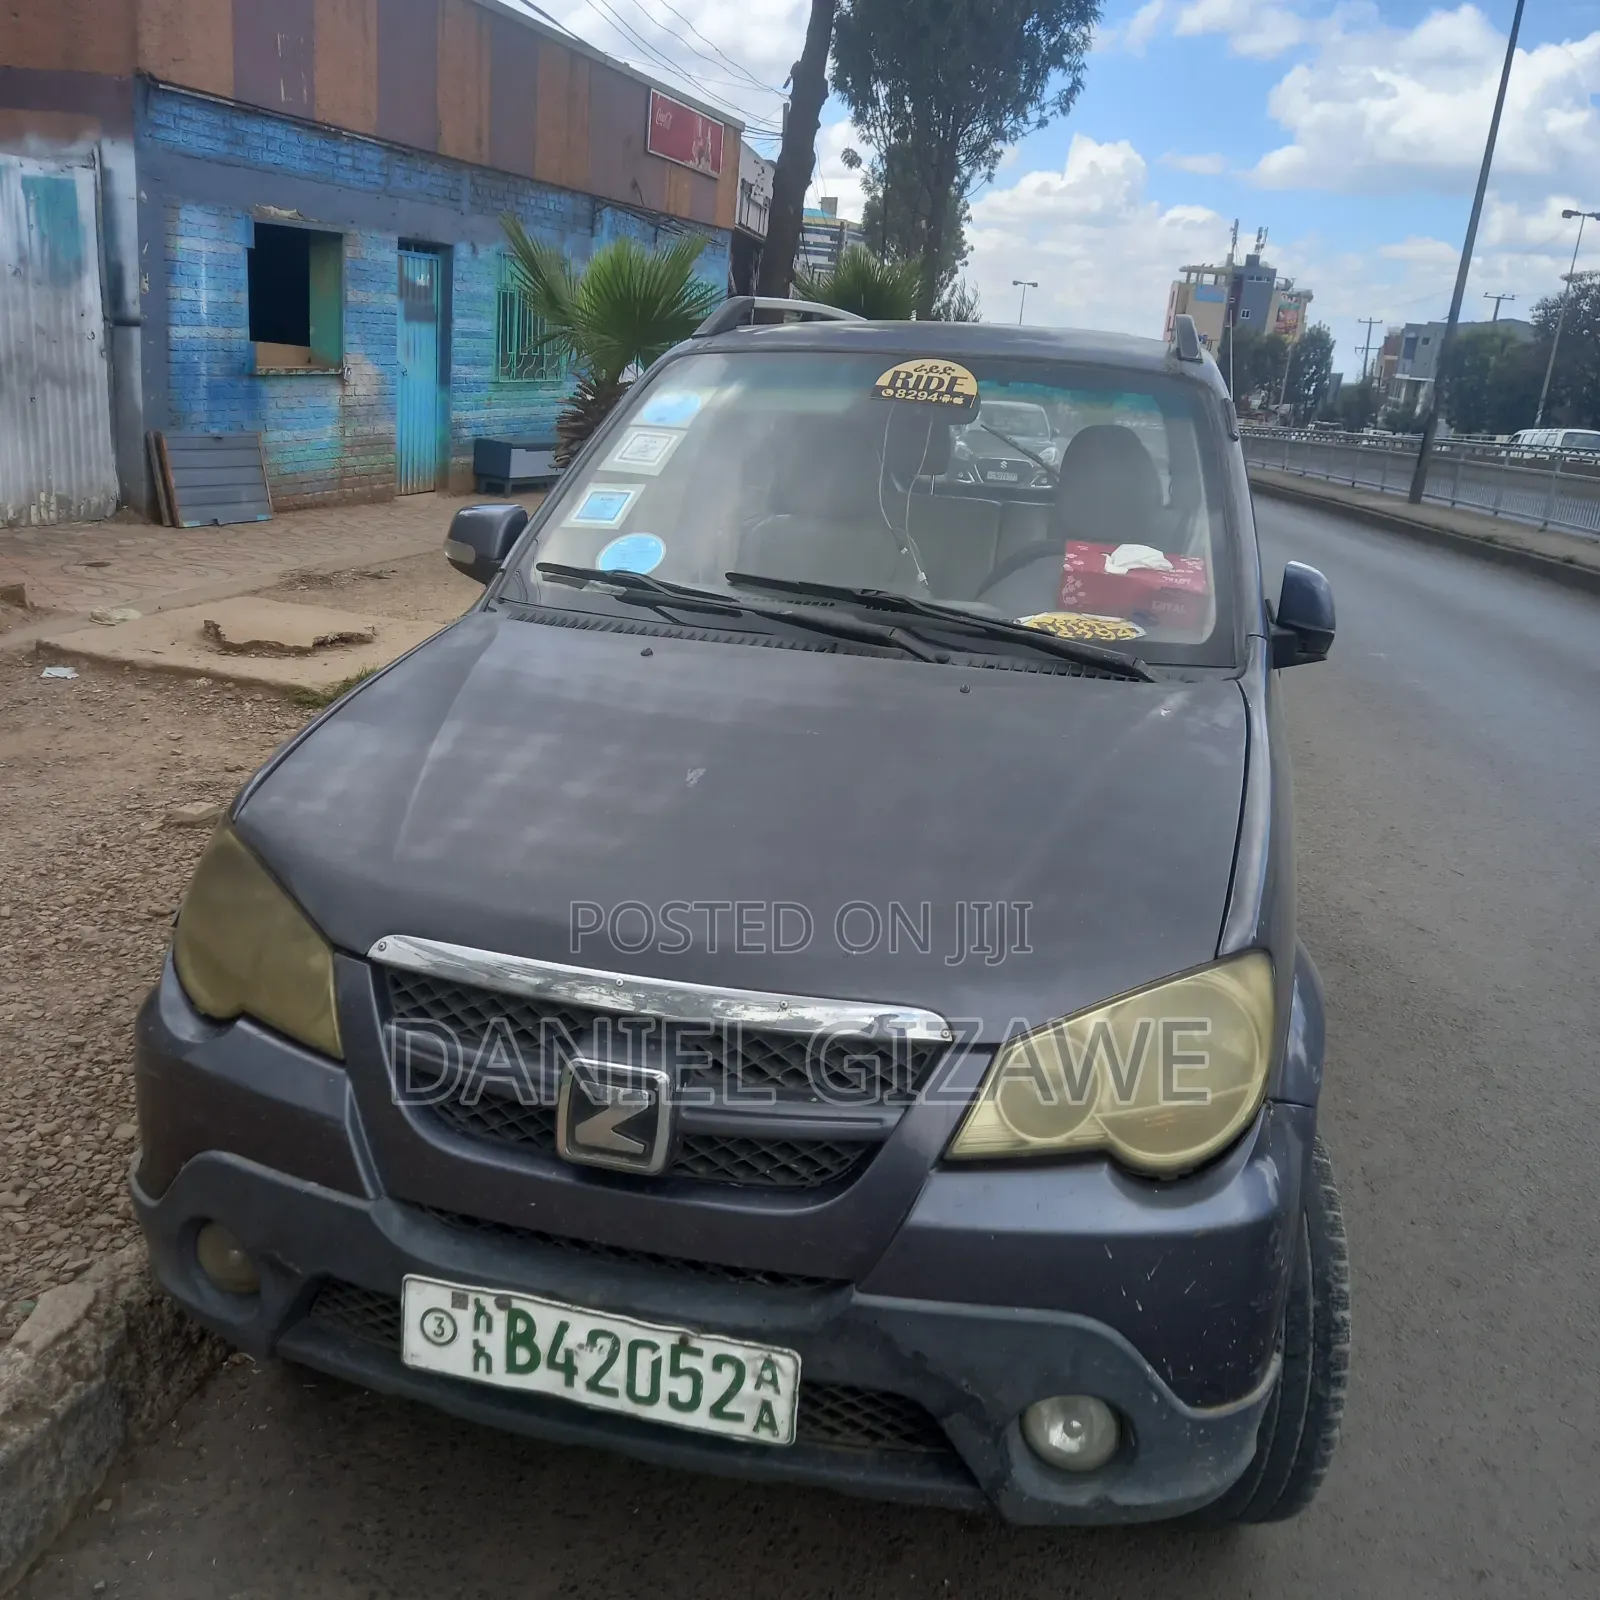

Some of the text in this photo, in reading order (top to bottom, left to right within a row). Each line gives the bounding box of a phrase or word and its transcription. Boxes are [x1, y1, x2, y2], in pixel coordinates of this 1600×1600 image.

[887, 370, 968, 394] RIDE
[895, 388, 938, 402] 8294
[433, 1316, 445, 1337] 3
[505, 1307, 746, 1422] B42052
